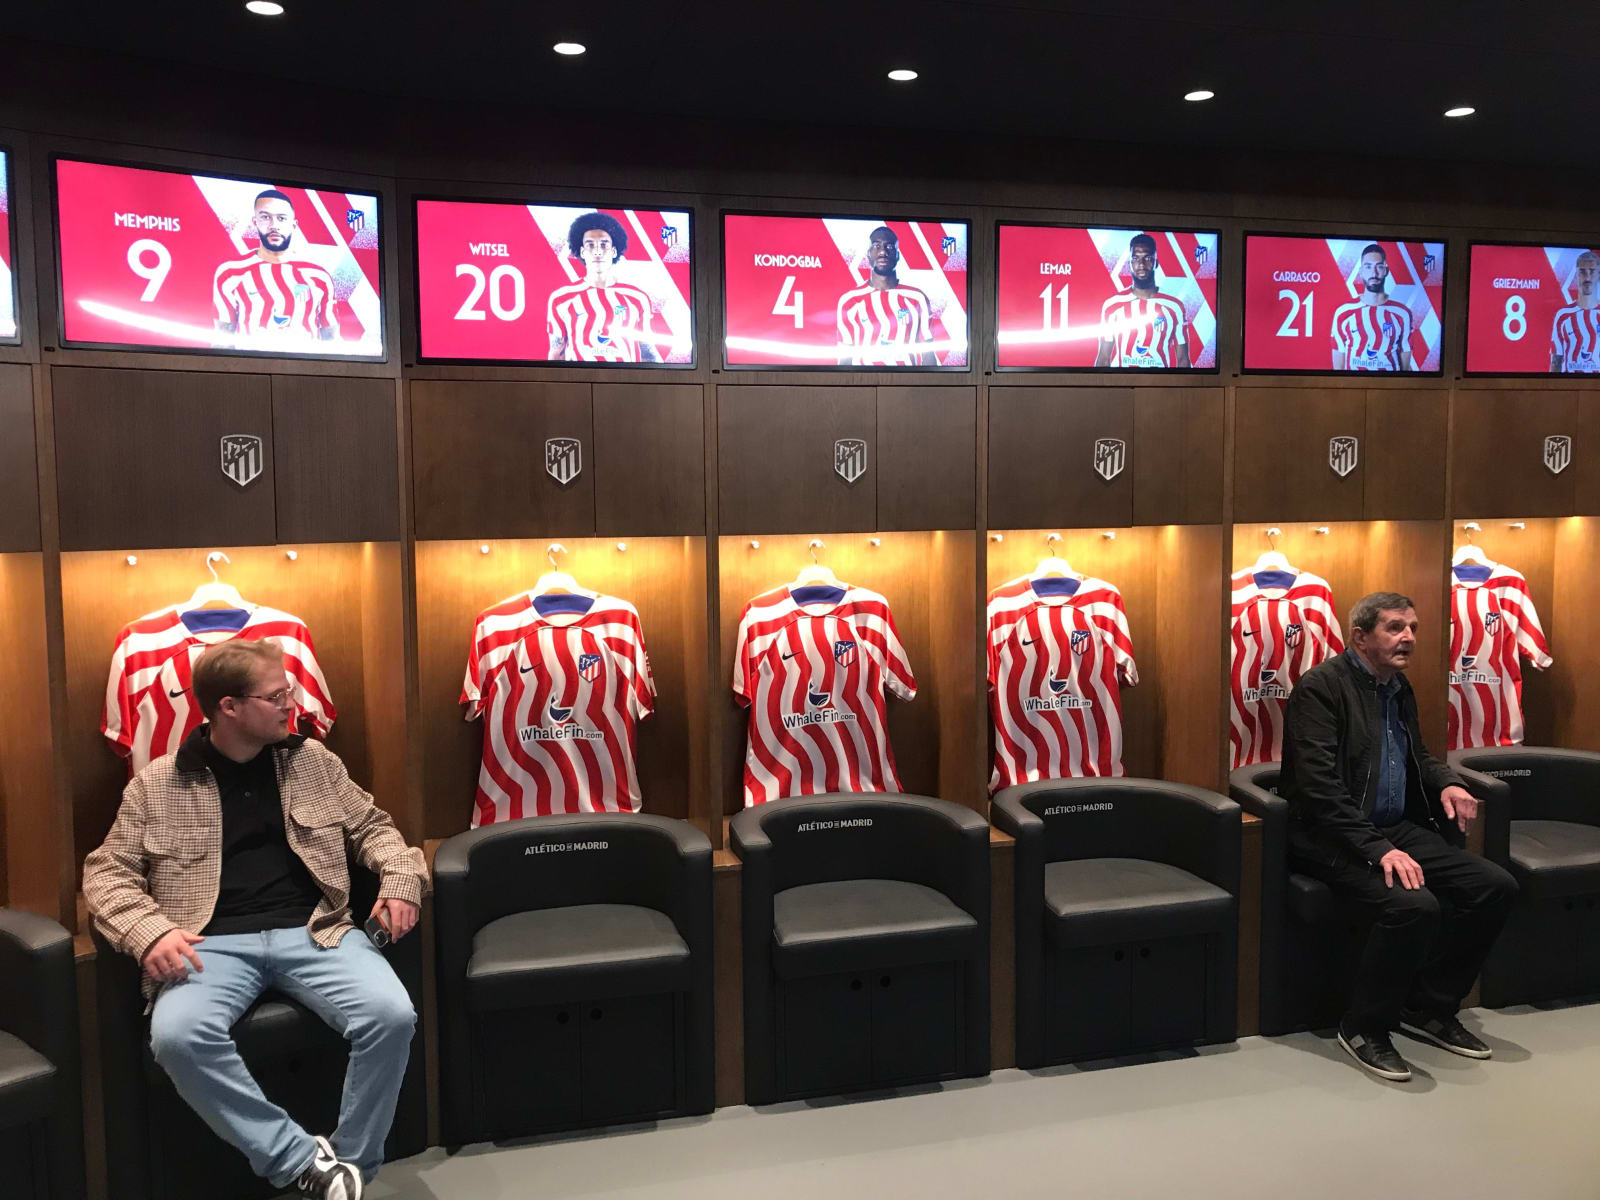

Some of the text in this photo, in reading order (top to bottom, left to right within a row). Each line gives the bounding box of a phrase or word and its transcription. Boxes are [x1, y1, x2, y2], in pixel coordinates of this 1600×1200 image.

[114, 212, 181, 232] MEMPHIS
[468, 242, 510, 257] WITSEL
[754, 254, 822, 268] KONDOGBIA
[1040, 262, 1072, 275] LEMAR
[127, 238, 172, 302] 9
[1273, 271, 1321, 283] CARRASCO
[1493, 277, 1541, 289] GRIEZMANN
[454, 263, 526, 321] 20
[772, 276, 803, 329] 4
[1039, 282, 1069, 332] 11
[1276, 289, 1314, 337] 21
[1503, 295, 1527, 342] 8
[520, 725, 603, 741] WhaleFin.com
[1082, 802, 1114, 812] MADRID
[840, 818, 873, 828] MADRID
[524, 843, 566, 856] ATLÉTICO
[573, 841, 609, 851] MADRID
